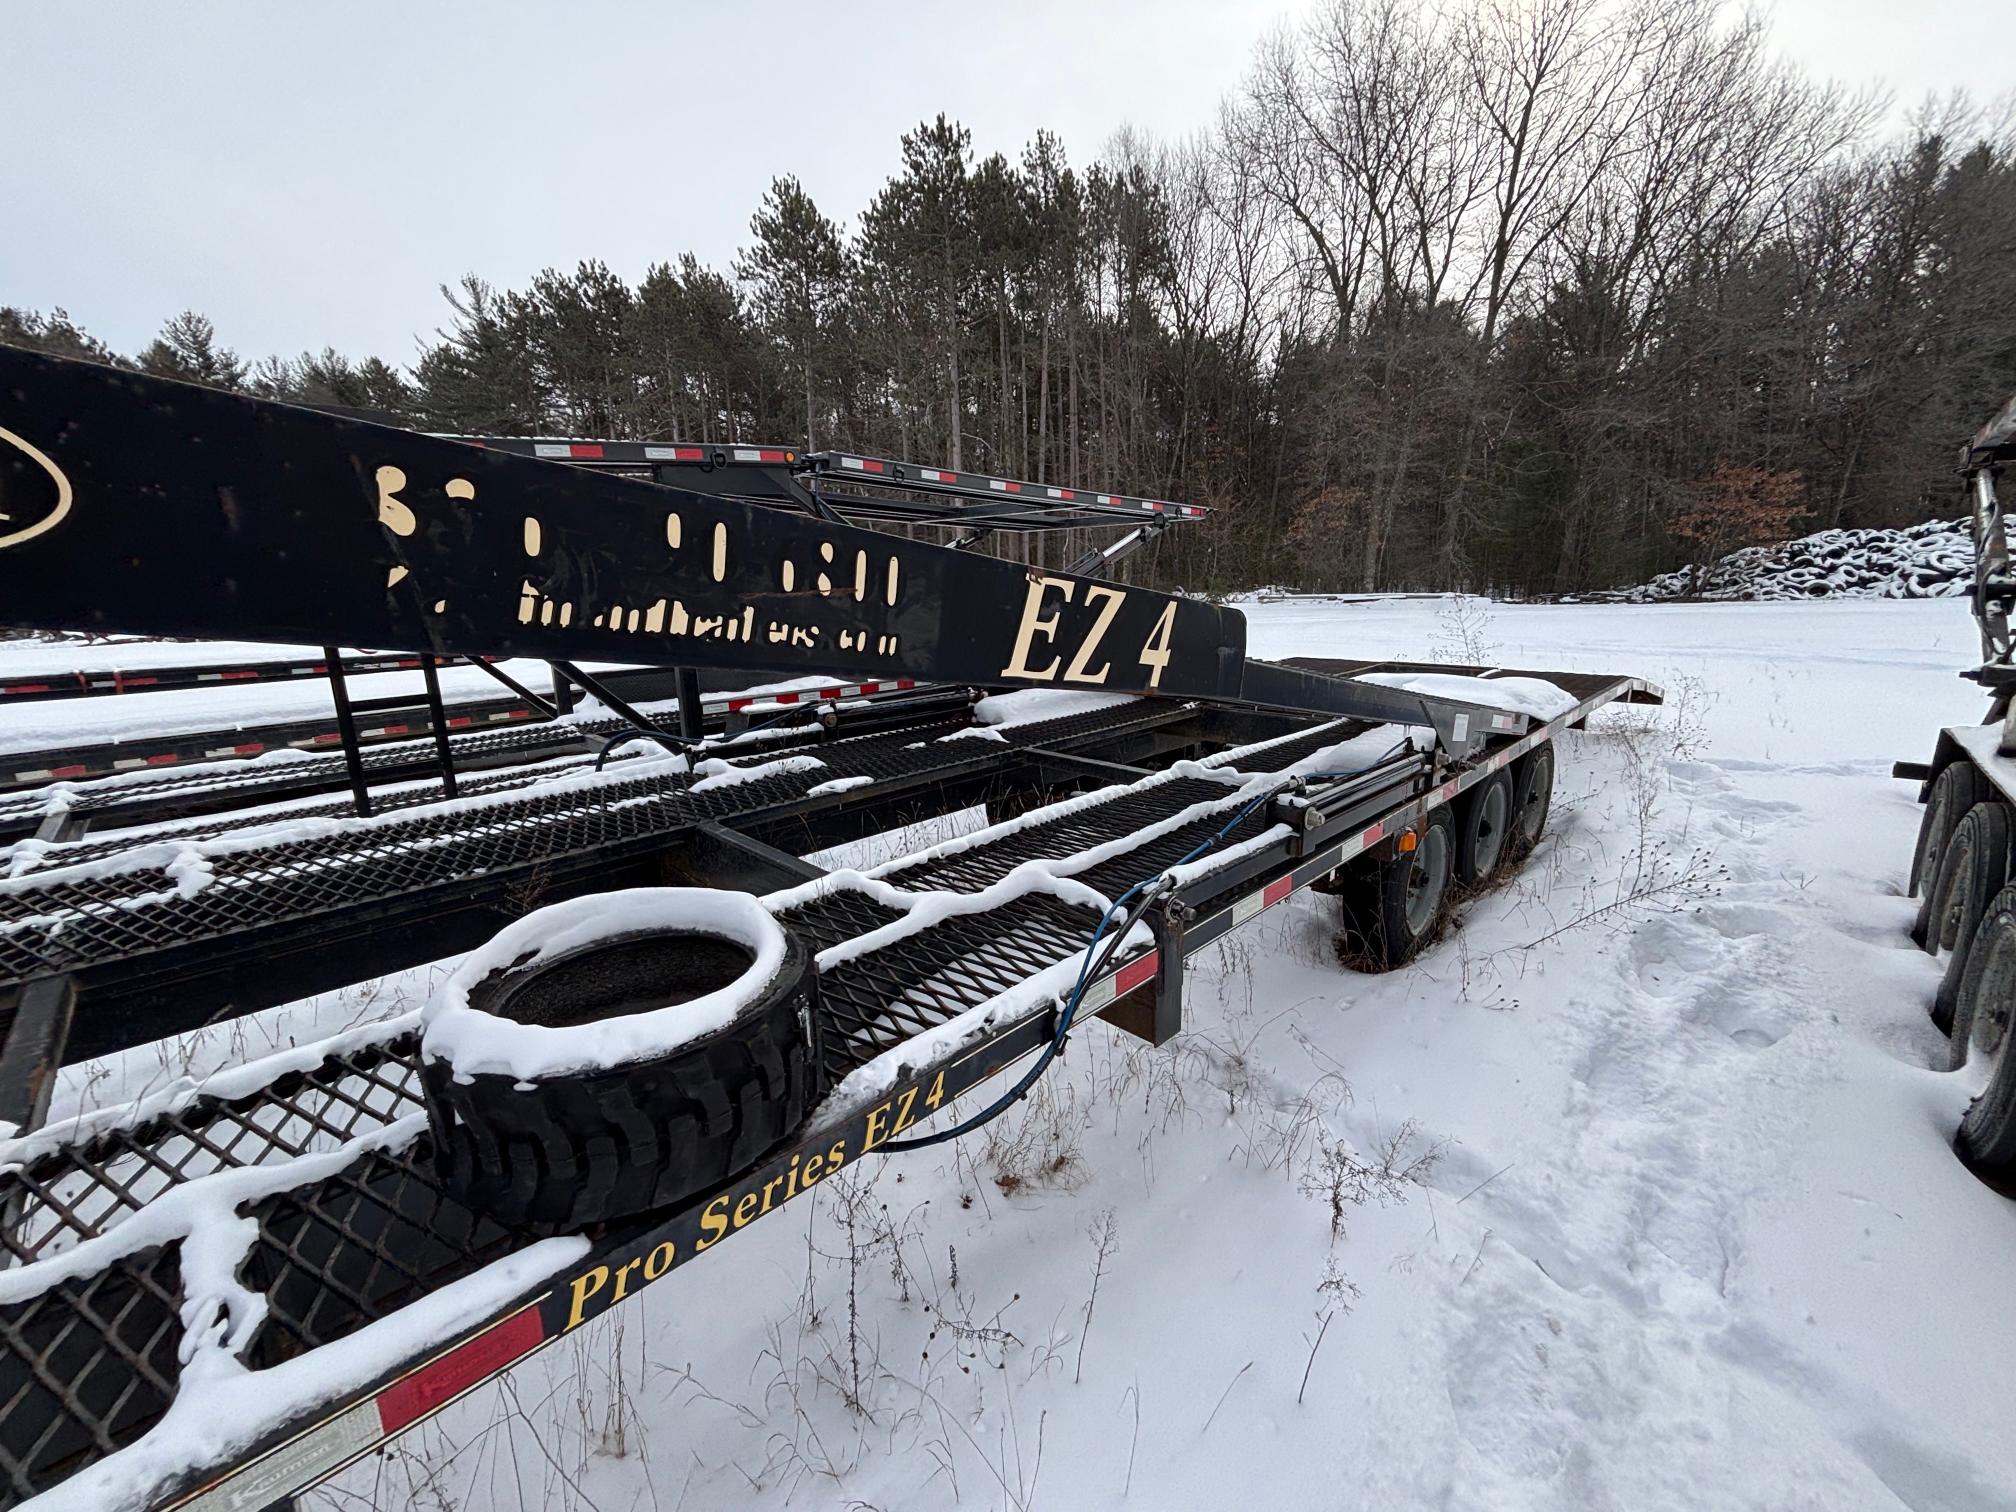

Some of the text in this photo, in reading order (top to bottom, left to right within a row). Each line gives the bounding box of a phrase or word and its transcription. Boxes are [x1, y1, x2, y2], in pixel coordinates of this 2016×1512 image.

[1001, 572, 1127, 684] EZ
[1138, 600, 1178, 688] 4
[562, 1070, 945, 1334] Pro Series EZ 4
